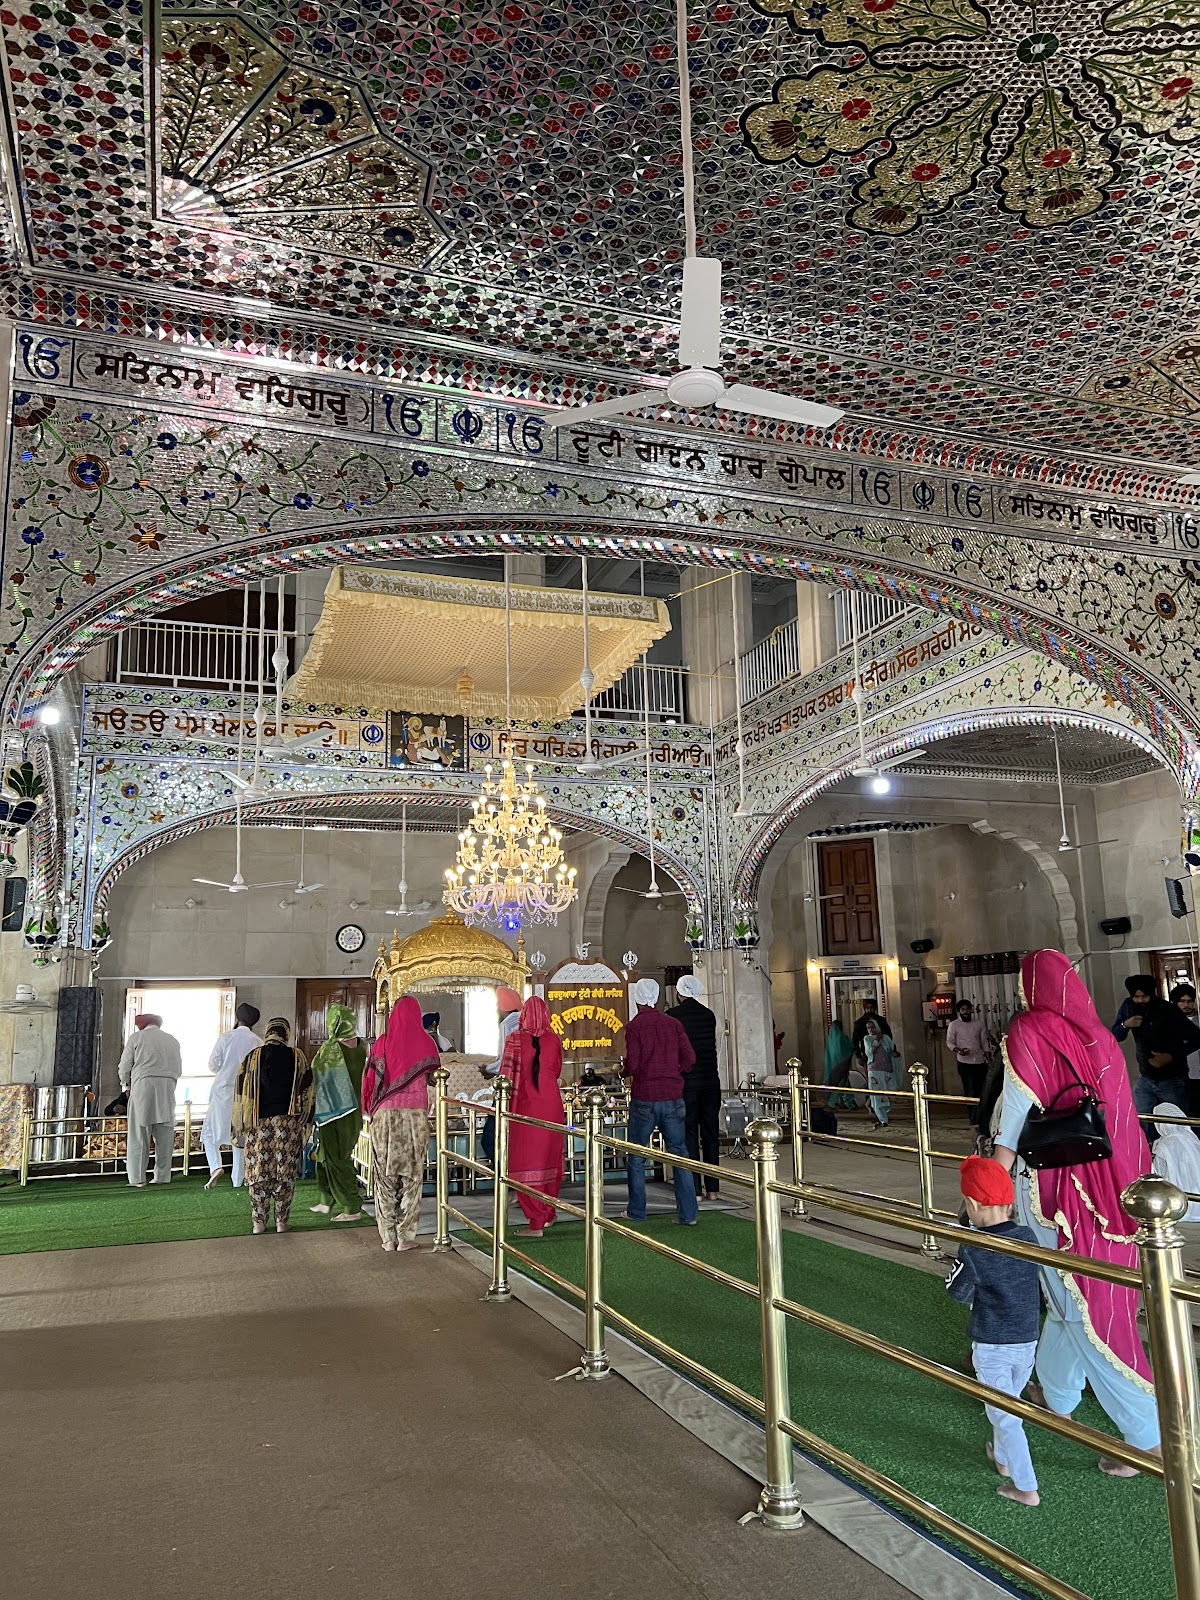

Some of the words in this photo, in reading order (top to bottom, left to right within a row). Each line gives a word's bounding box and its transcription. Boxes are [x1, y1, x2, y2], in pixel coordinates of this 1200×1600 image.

[570, 429, 625, 463] ਟੂਟੀ
[561, 1005, 595, 1024] ਦਰਬਾਰ
[596, 1007, 624, 1034] ਸਾਹਿਬ
